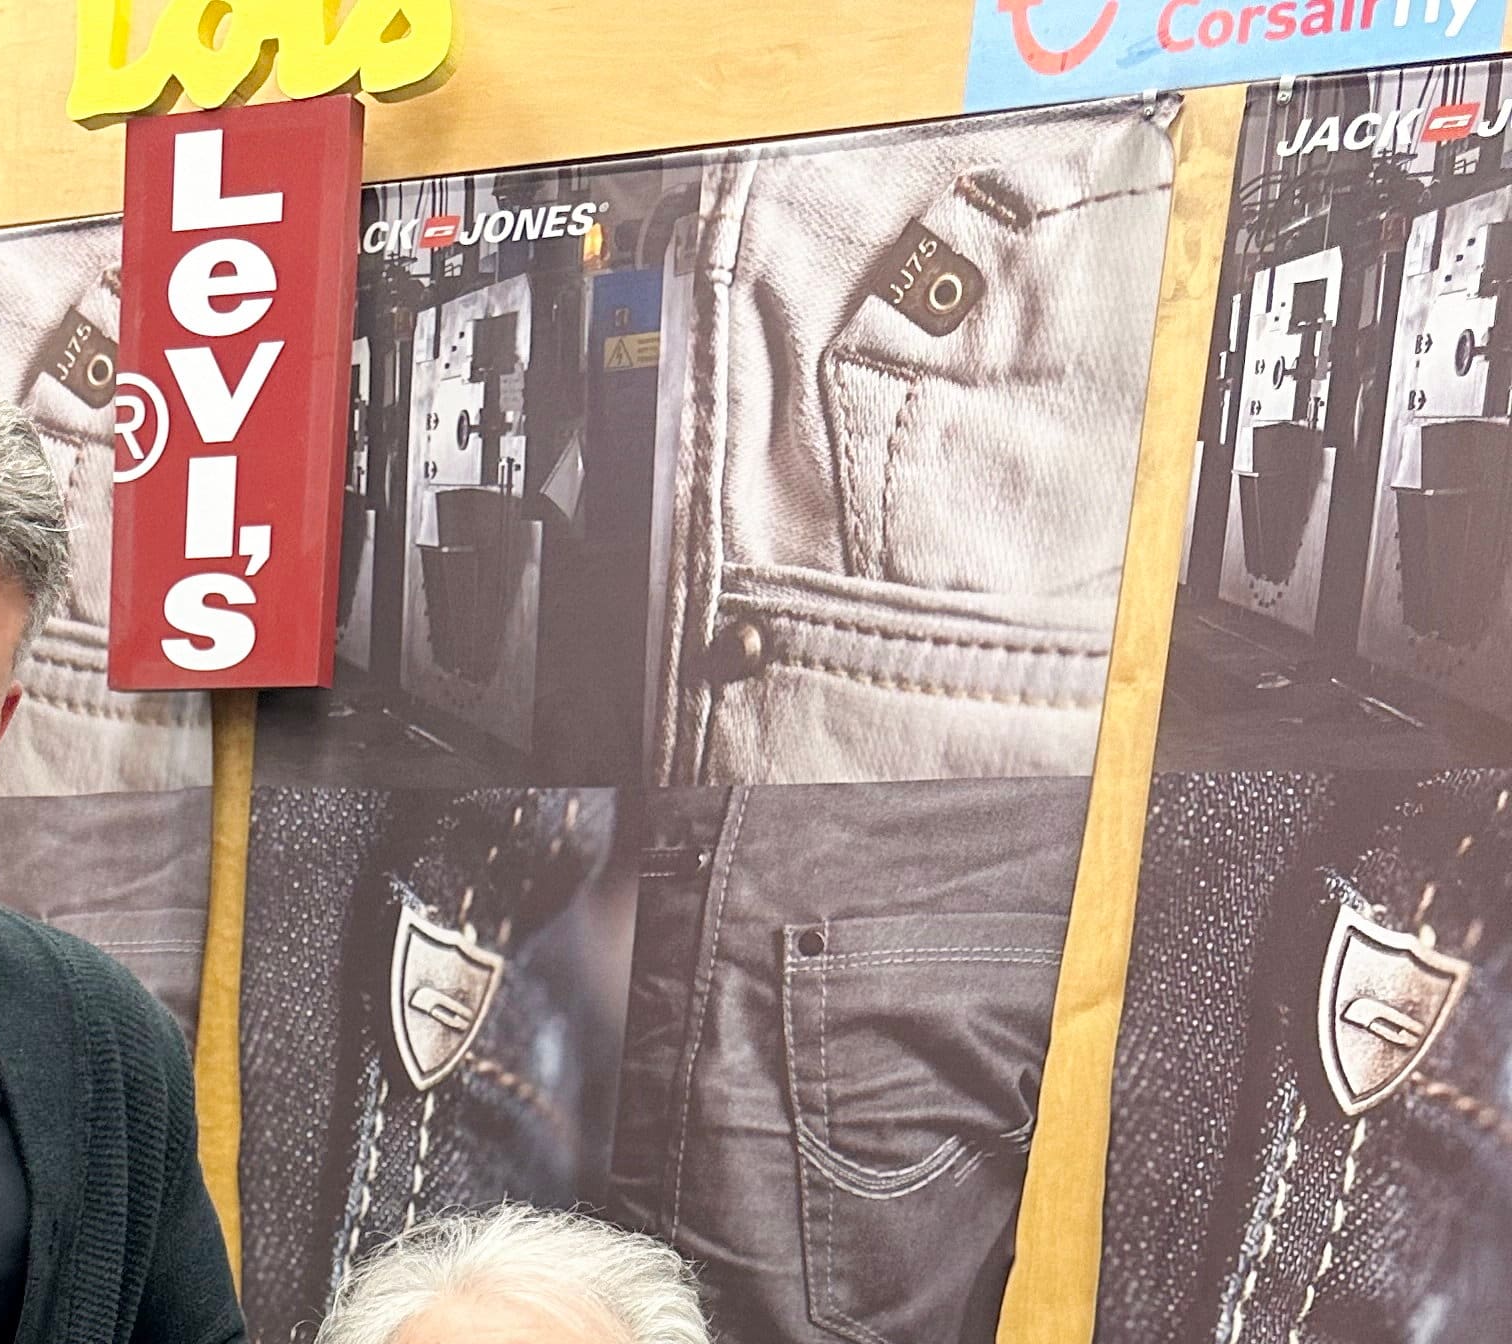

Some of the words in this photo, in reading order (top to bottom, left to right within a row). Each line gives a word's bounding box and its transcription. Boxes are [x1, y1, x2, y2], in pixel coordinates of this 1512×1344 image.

[1276, 106, 1425, 158] JACK
[357, 217, 420, 254] CK
[459, 201, 599, 246] JONES
[889, 238, 938, 304] JJ75
